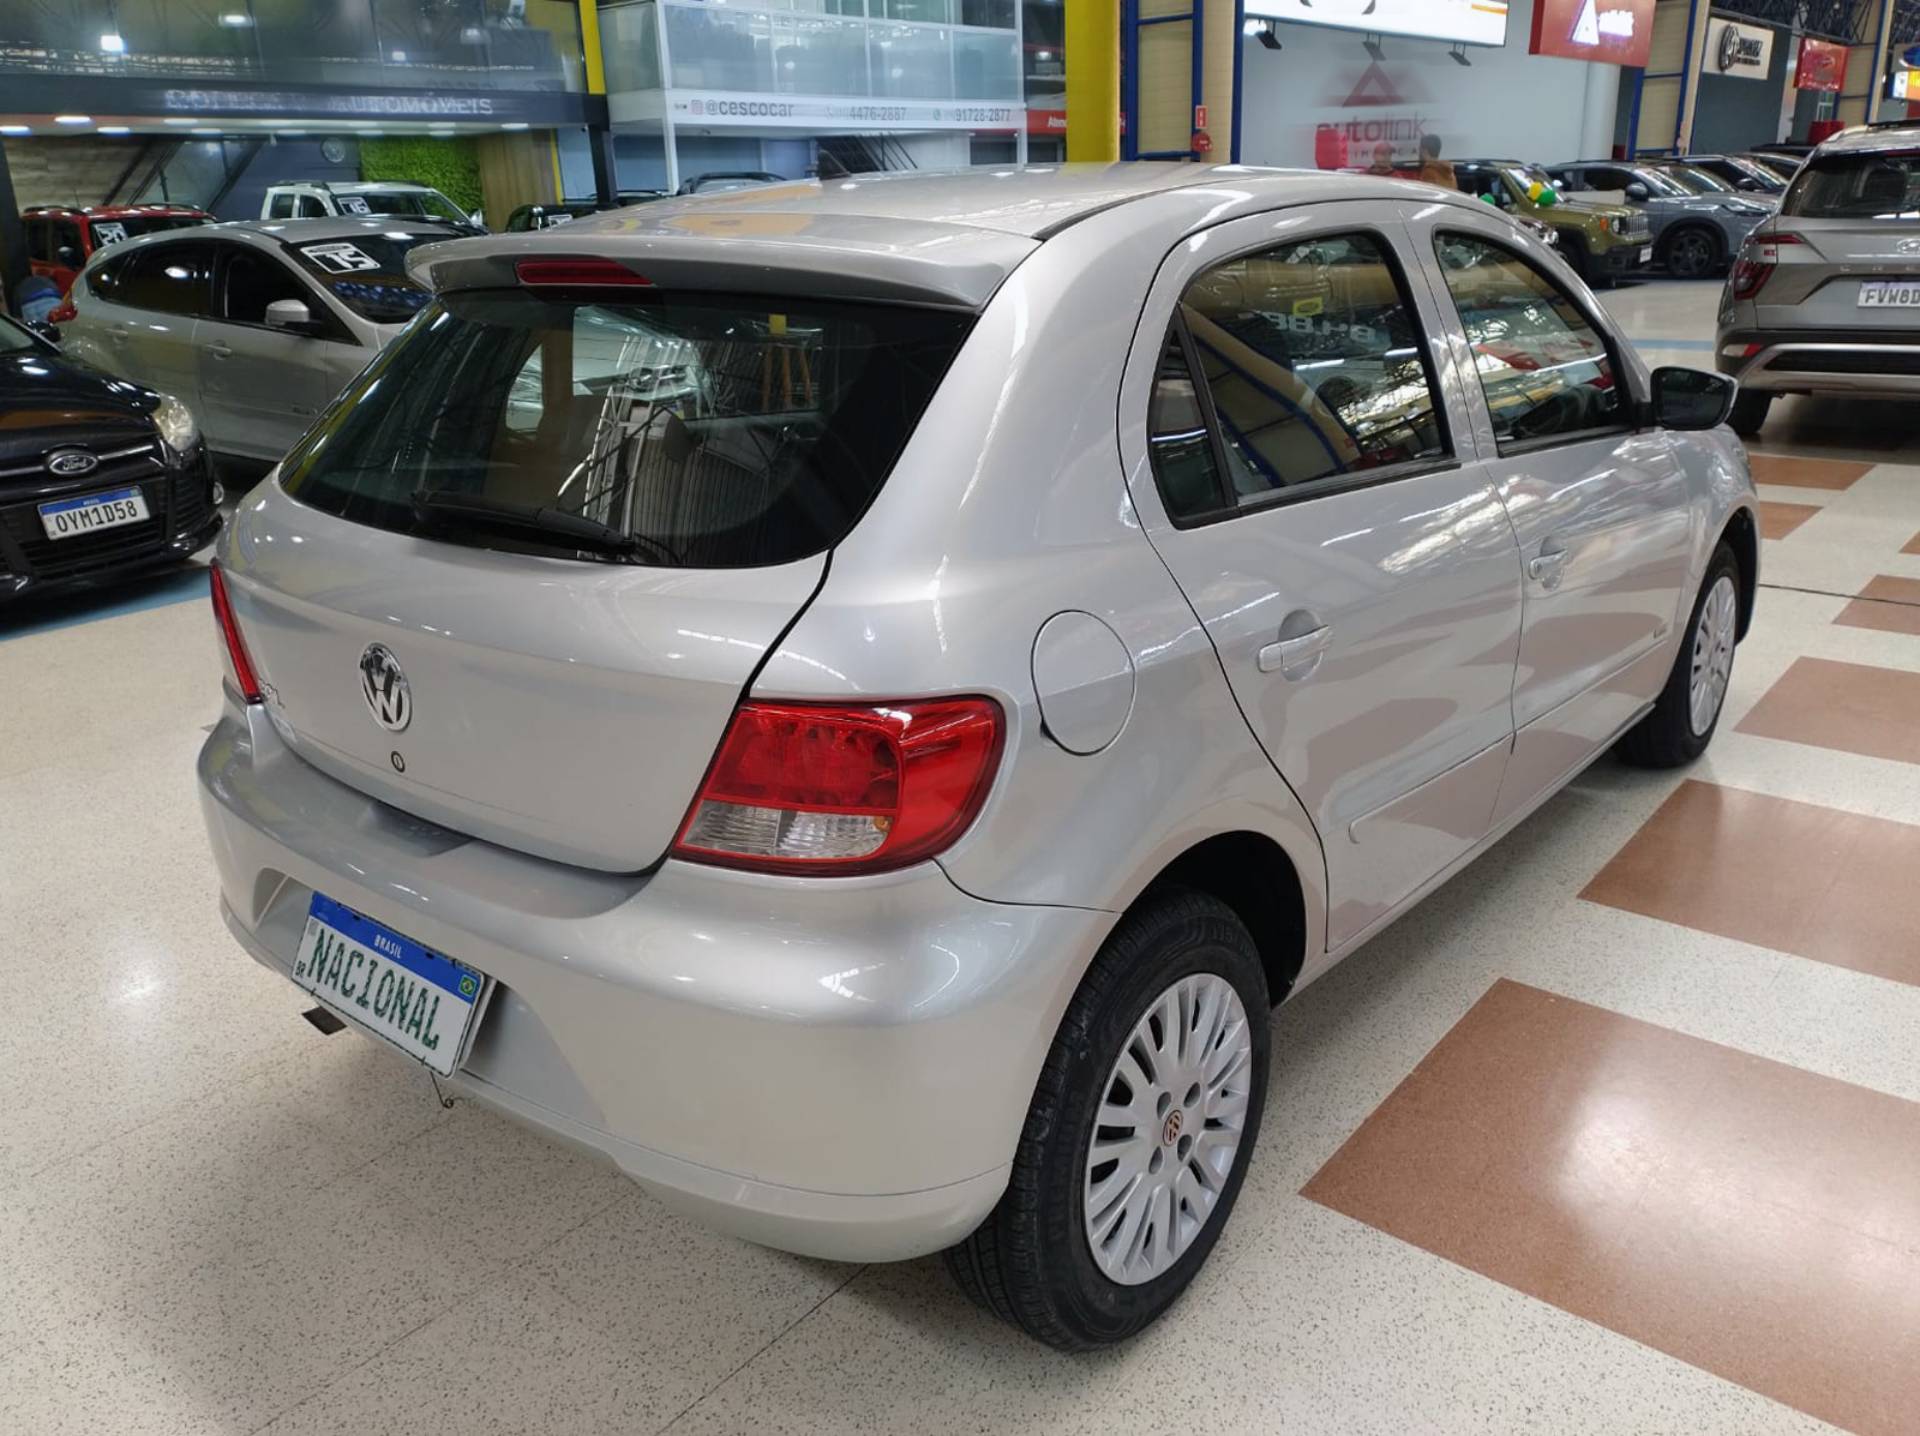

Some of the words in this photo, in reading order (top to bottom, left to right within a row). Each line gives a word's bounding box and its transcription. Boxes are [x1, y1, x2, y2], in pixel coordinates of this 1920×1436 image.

[705, 99, 794, 118] @cescocar
[850, 106, 907, 121] 4476-2887
[955, 107, 1011, 123] 91728-2877
[325, 250, 378, 269] 15
[62, 455, 87, 471] Ford
[374, 934, 402, 959] BRASIL
[306, 928, 440, 1050] NACIONAL
